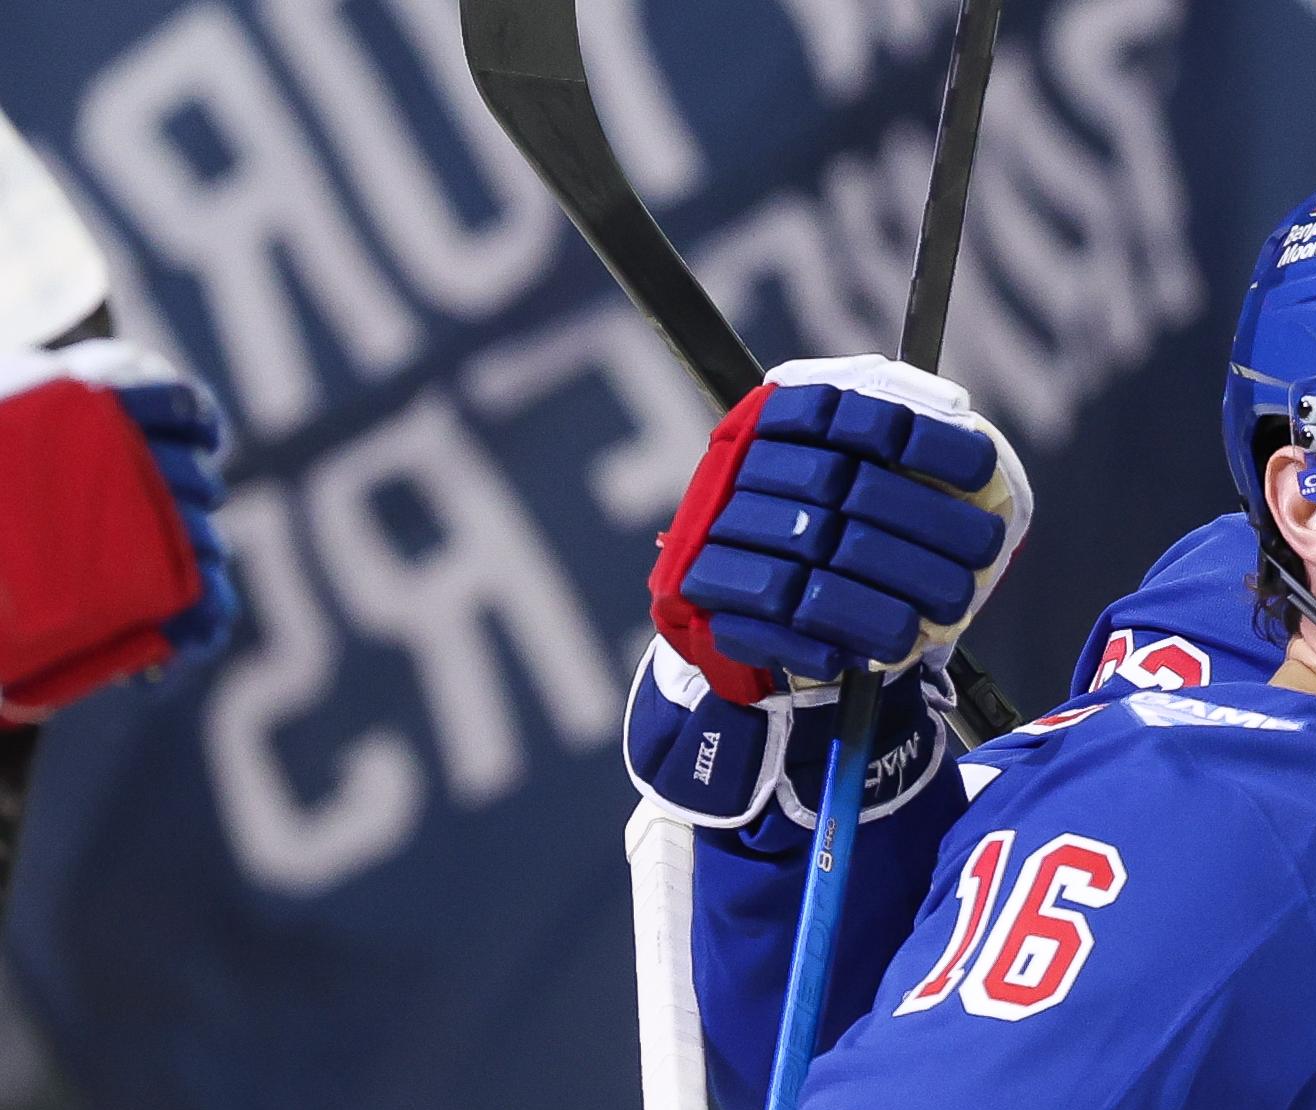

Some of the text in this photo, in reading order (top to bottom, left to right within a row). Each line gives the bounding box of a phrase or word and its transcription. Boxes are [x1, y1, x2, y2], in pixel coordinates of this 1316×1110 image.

[693, 731, 721, 786] MIKA
[816, 850, 834, 873] 8
[892, 830, 1129, 1022] 16
